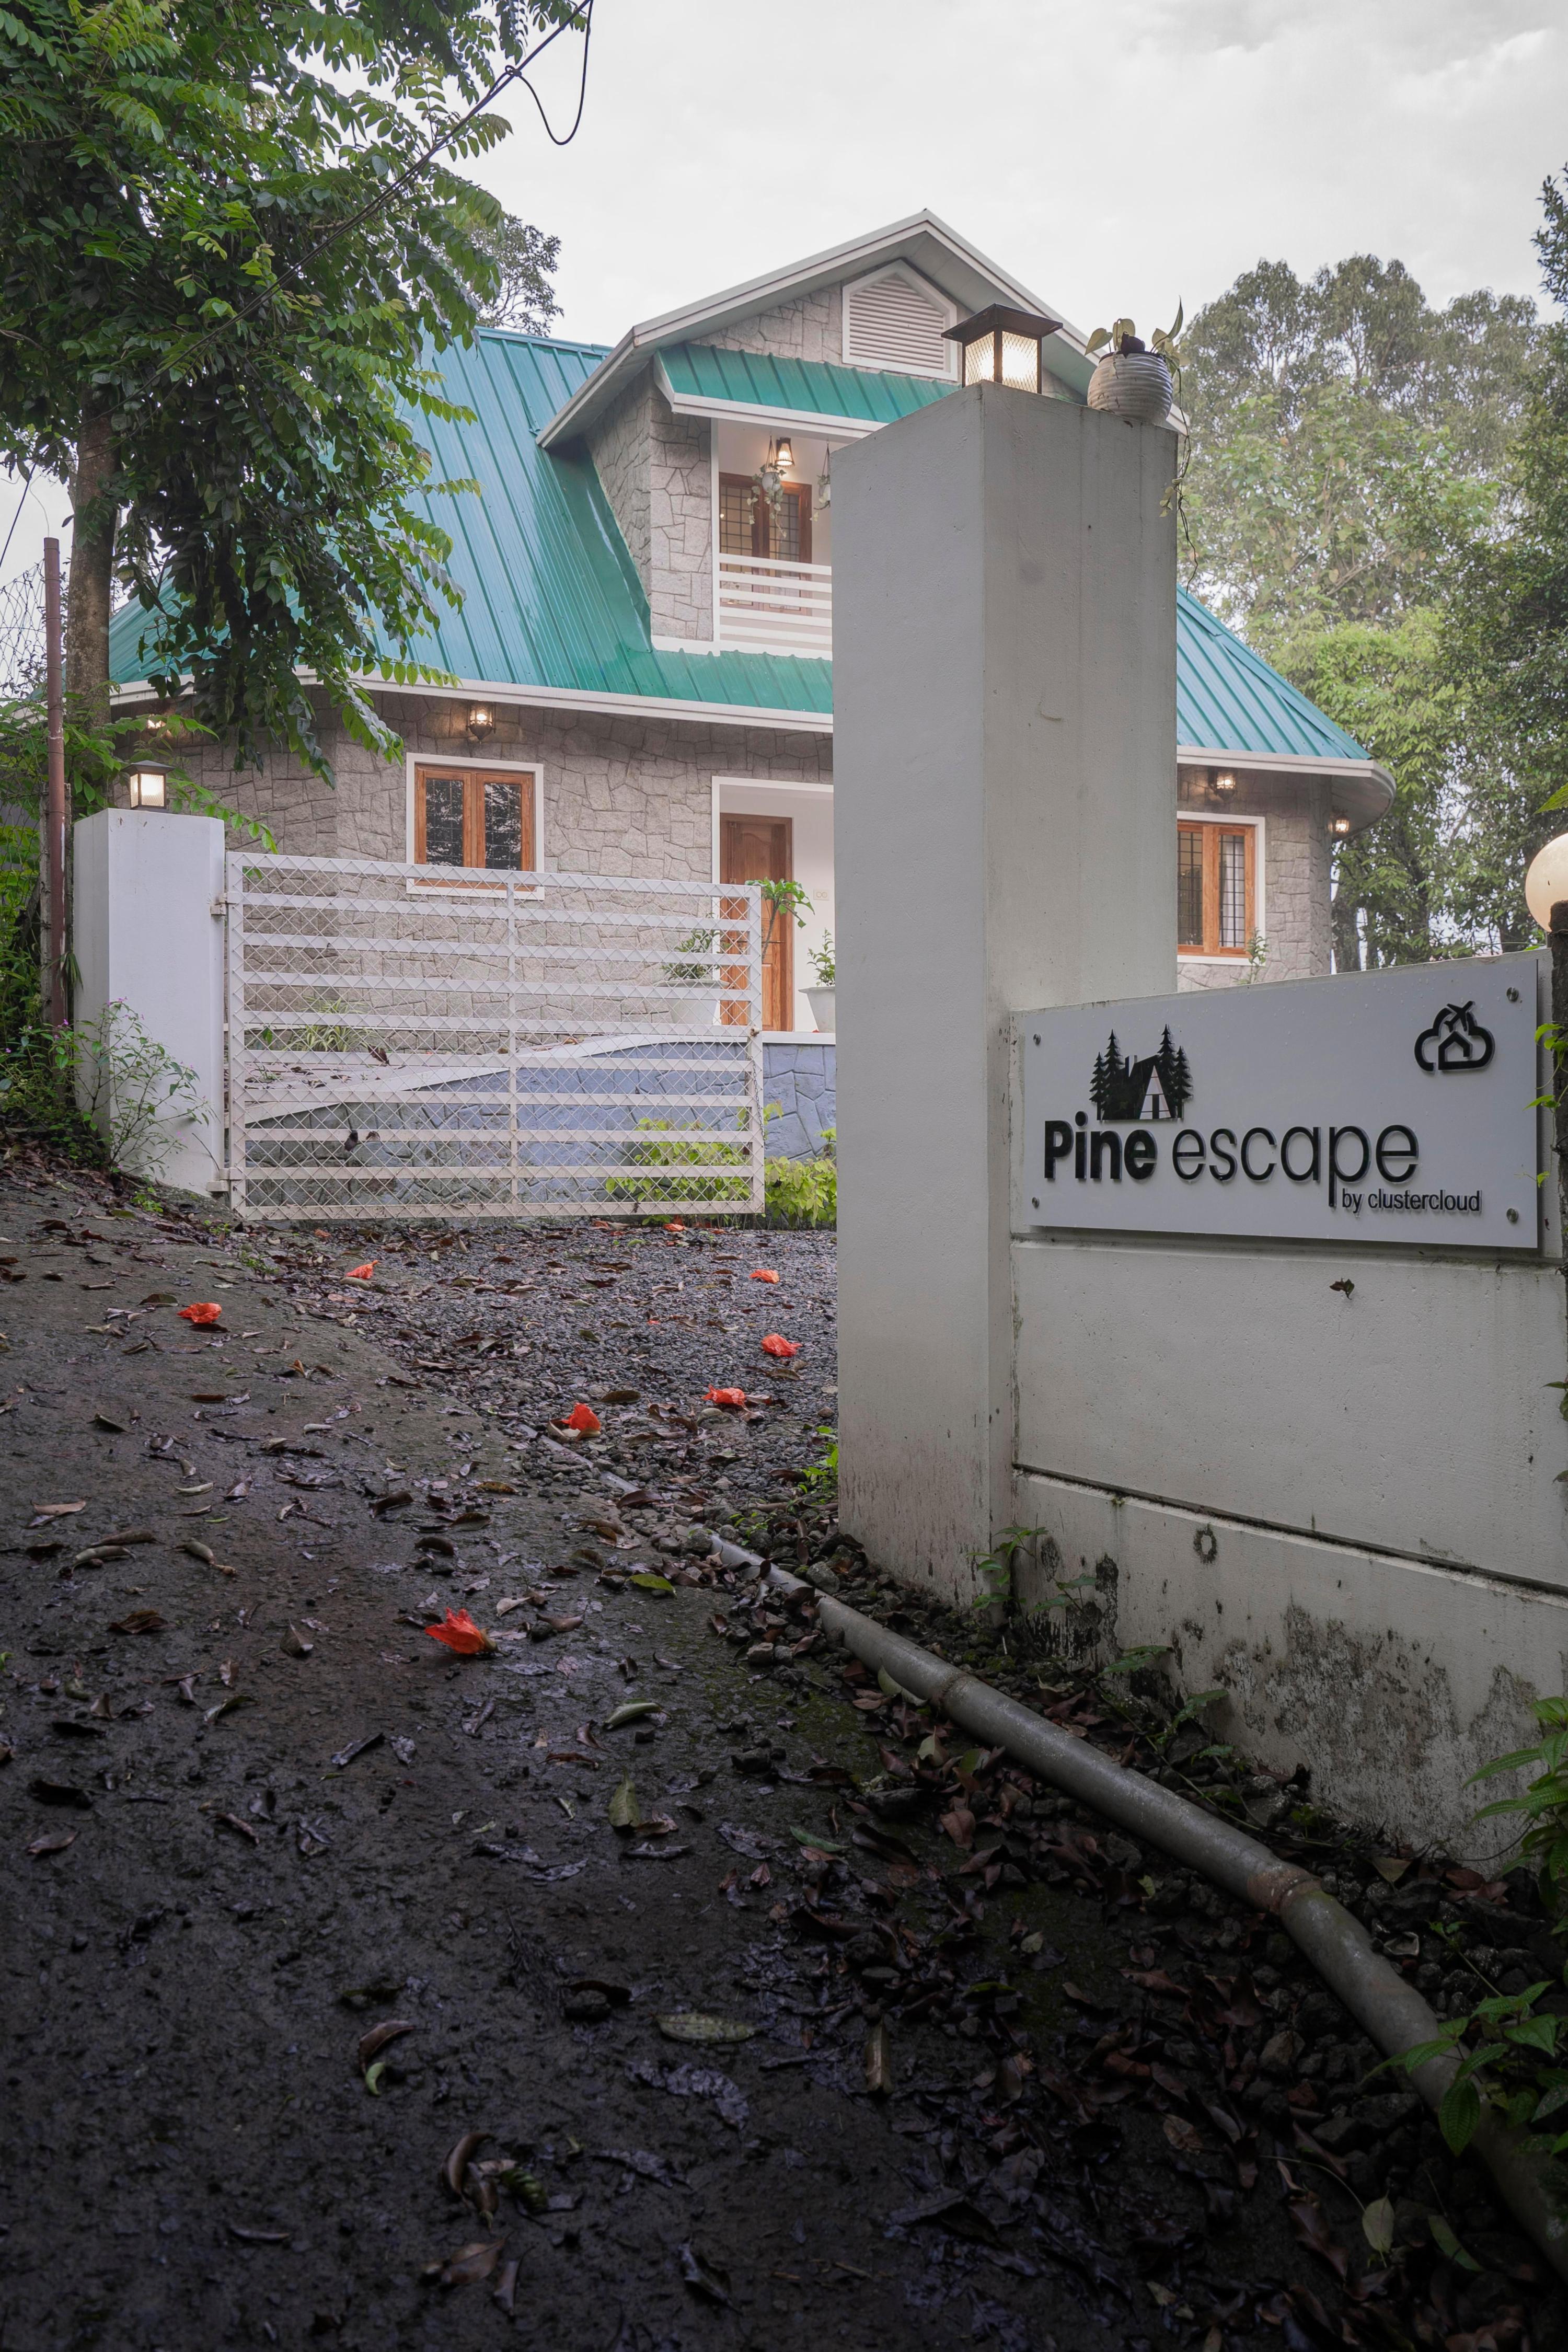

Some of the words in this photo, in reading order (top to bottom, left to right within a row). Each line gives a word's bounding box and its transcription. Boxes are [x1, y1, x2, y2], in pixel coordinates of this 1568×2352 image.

[1044, 1111, 1157, 1180] Pine
[1172, 1124, 1418, 1207] escape
[1342, 1188, 1364, 1213] by
[1367, 1189, 1481, 1212] clustercloud
